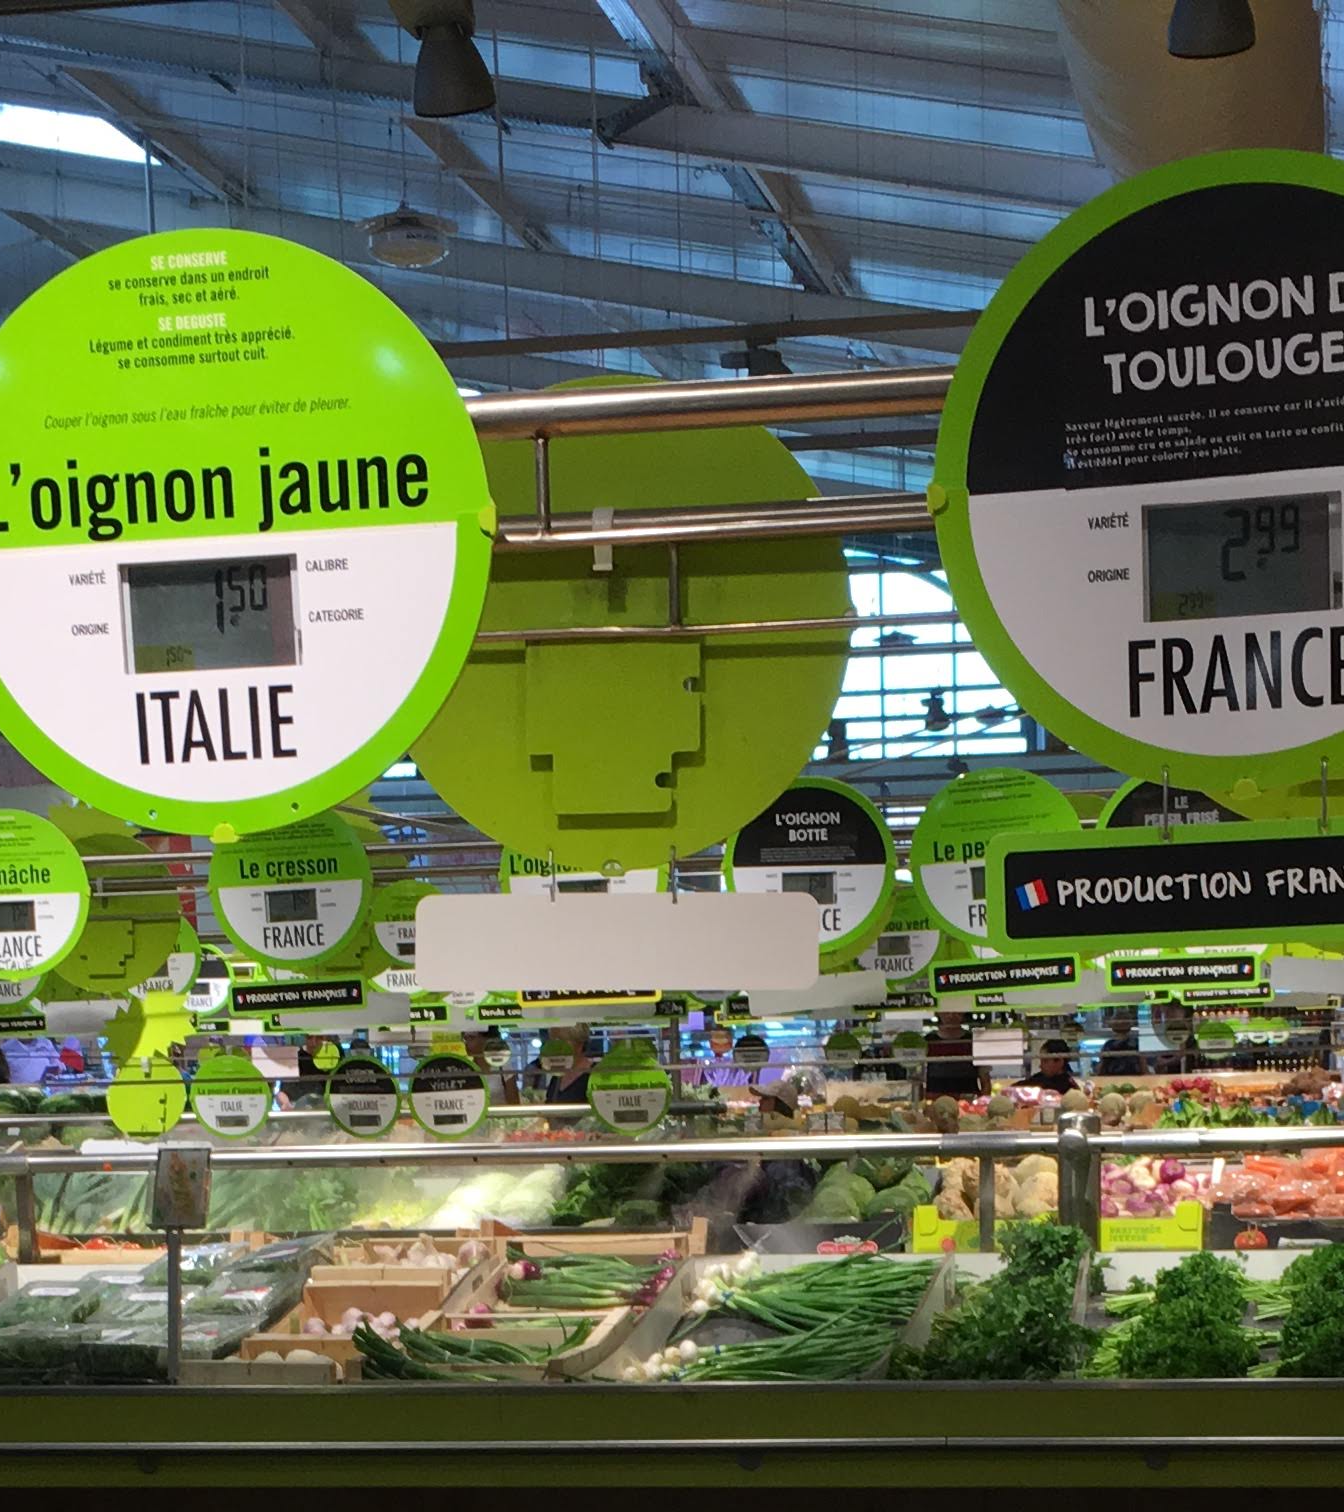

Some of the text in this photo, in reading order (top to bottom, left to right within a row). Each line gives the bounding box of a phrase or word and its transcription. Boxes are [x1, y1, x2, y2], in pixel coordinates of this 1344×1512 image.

[150, 250, 227, 271] SE CONSERVE
[108, 266, 269, 290] se conserve dans un endroit
[139, 293, 168, 307] frais,
[172, 293, 192, 304] sec
[195, 291, 207, 303] et
[1084, 275, 1315, 338] L'OIGNON
[158, 312, 226, 332] SE DEGUSTE
[89, 339, 133, 355] Légume
[137, 336, 148, 349] et
[151, 331, 212, 349] condiment
[215, 330, 237, 344] très
[117, 358, 131, 370] se
[134, 352, 195, 368] consomme
[199, 350, 240, 364] surtout
[44, 415, 82, 431] Couper
[84, 411, 129, 429] l'oignon
[131, 411, 156, 424] sous
[160, 408, 186, 421] l'eau
[189, 403, 228, 420] fraîche
[231, 403, 256, 419] pour
[258, 399, 290, 415] éviter
[293, 398, 307, 412] de
[258, 447, 430, 532] jaune
[1088, 512, 1129, 530] VARIÉTÉ
[306, 557, 348, 572] CALIBRE
[69, 571, 106, 587] VARIÉTÉ
[1088, 568, 1130, 584] ORIGINE
[309, 607, 365, 623] CATEGORIE
[71, 623, 109, 637] ORIGINE
[135, 685, 297, 765] ITALIE
[775, 812, 840, 826] L'OIGNON
[788, 828, 828, 843] BOTTE
[933, 841, 950, 863] Le
[239, 857, 338, 879] Le cresson
[1058, 870, 1251, 908] PRODUCTION
[905, 917, 929, 931] vert
[262, 923, 325, 949] FRANCE
[874, 957, 913, 971] FRANCE
[1125, 964, 1238, 978] PRODUCTION FRANÇAISE
[949, 965, 1059, 984] PRODUCTION FRANÇAISE
[246, 992, 300, 1005] PRODUCTION
[220, 1100, 244, 1112] ITALIE
[435, 1100, 464, 1111] FRANCE
